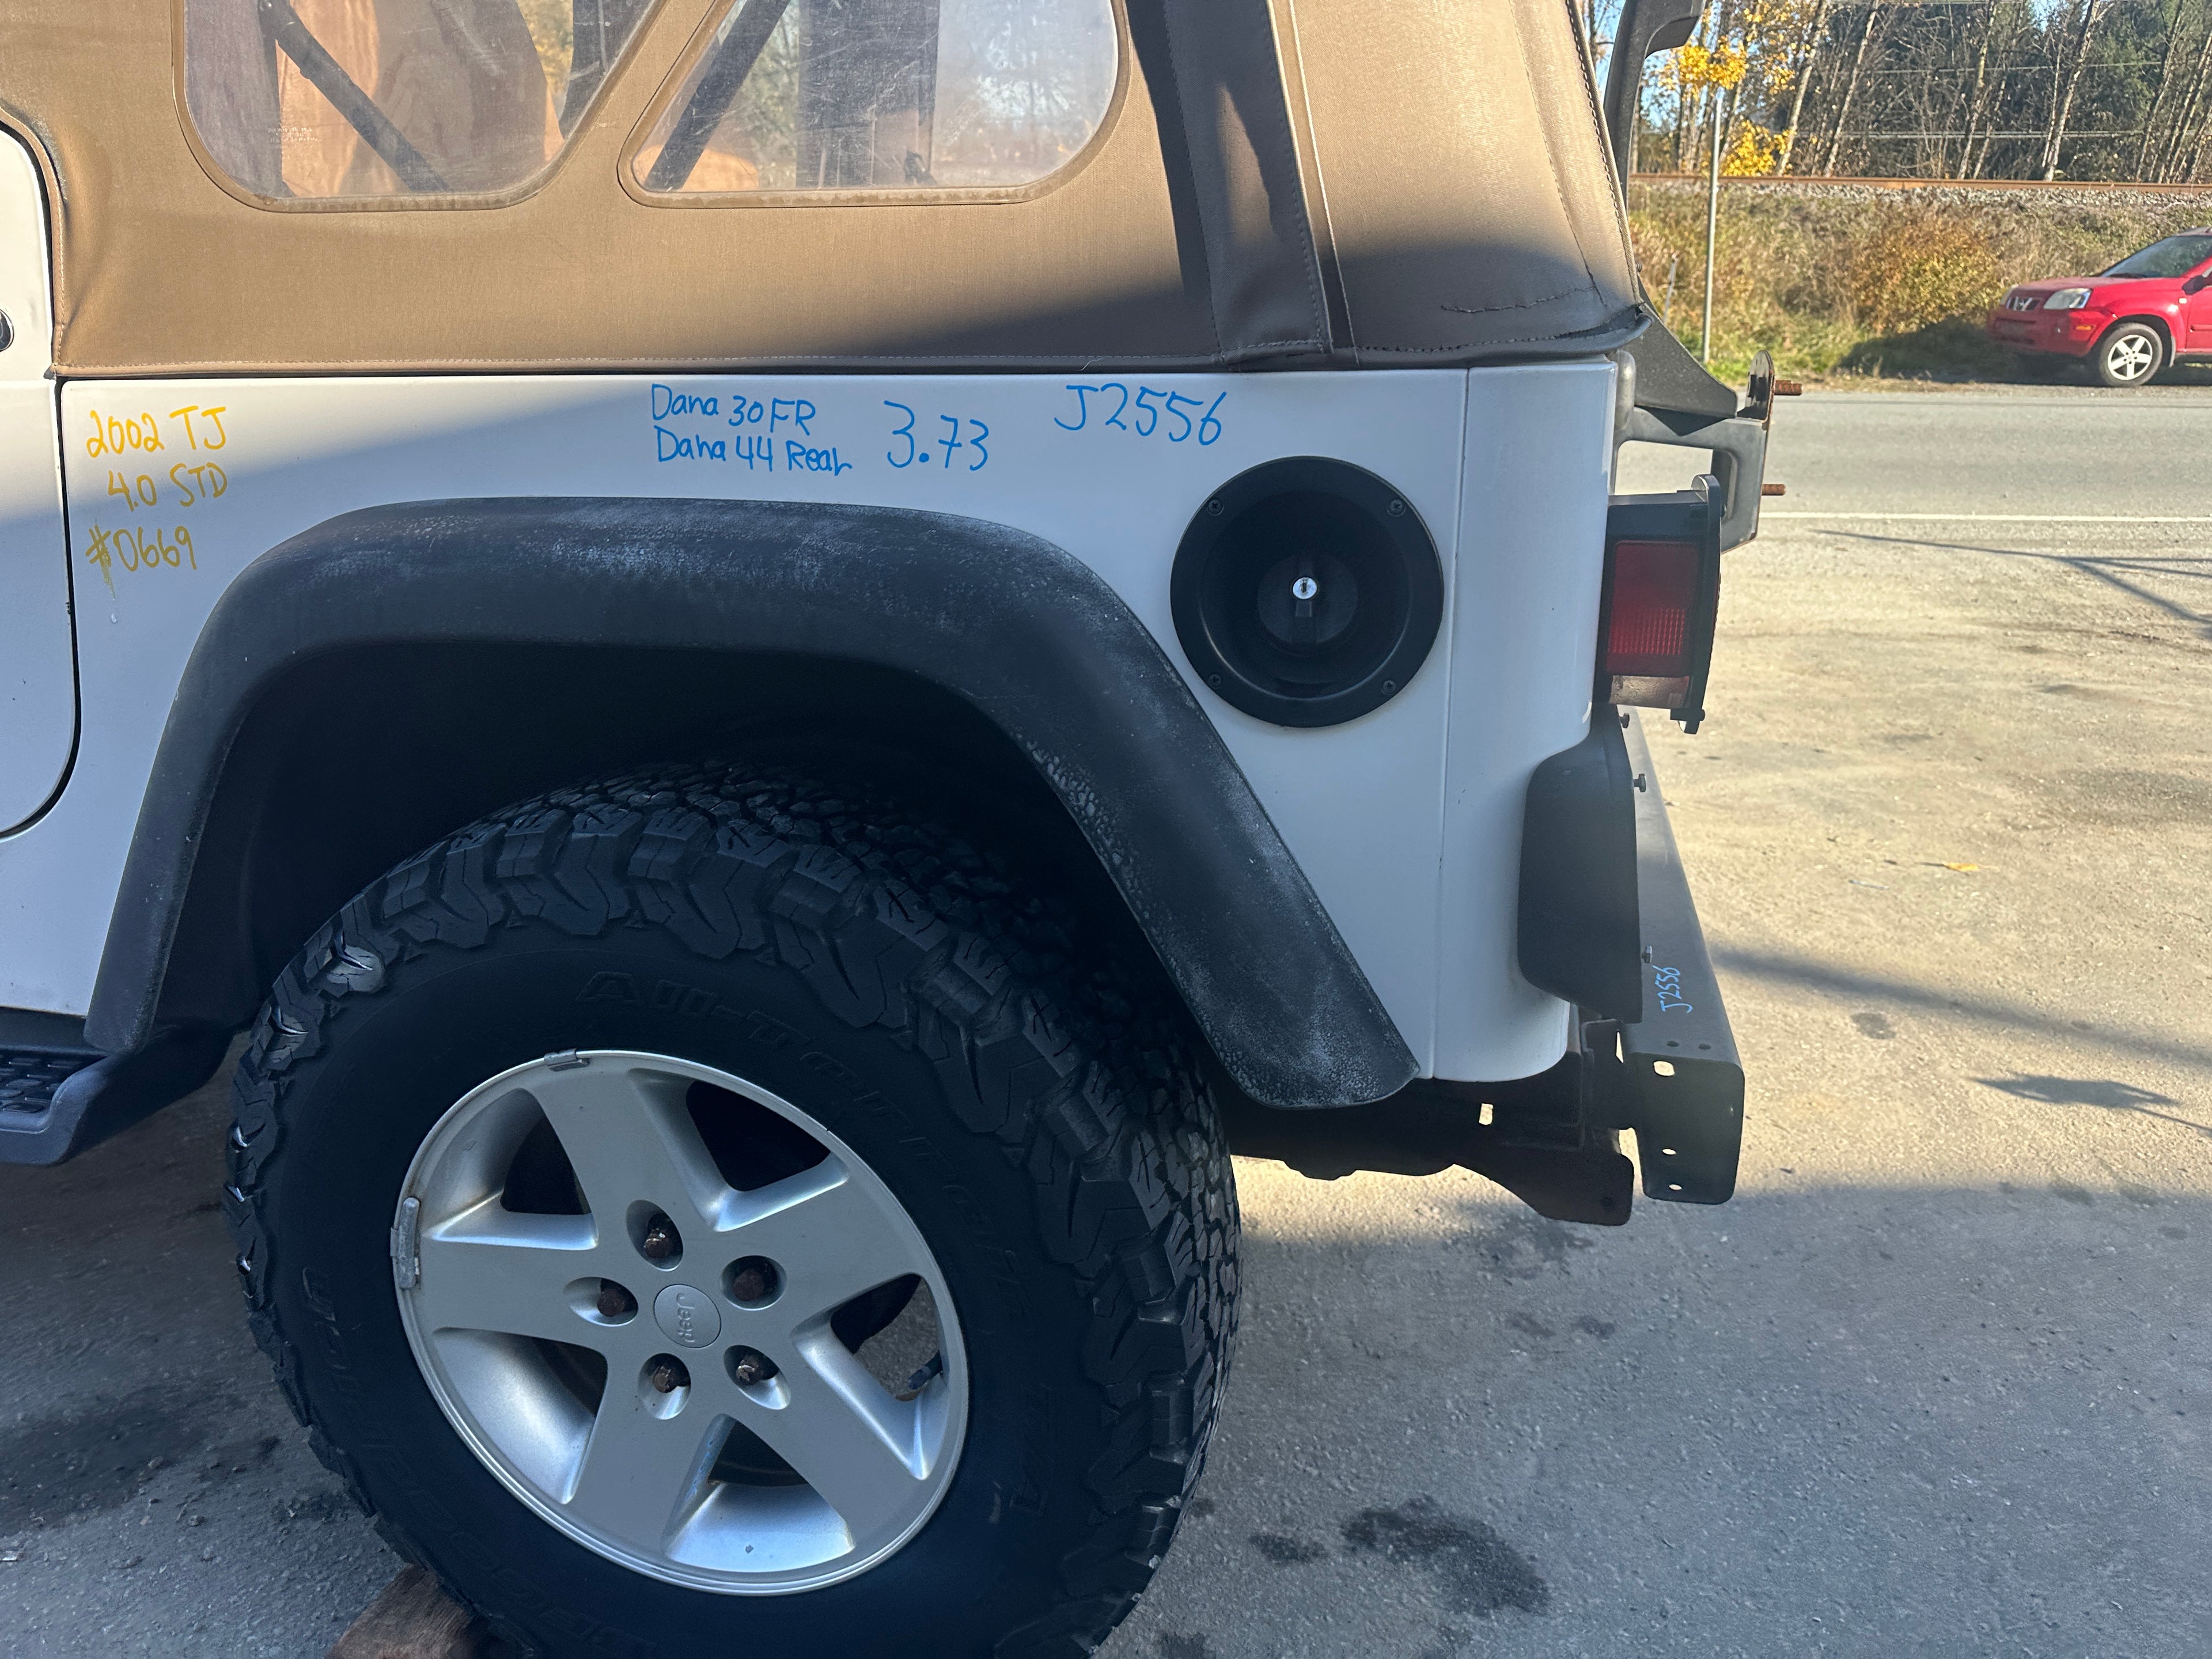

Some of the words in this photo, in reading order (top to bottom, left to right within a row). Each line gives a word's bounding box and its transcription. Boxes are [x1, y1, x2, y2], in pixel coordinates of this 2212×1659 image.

[652, 383, 719, 421] Dana
[1053, 382, 1227, 446] J2556
[86, 410, 165, 458] 2002
[169, 405, 227, 450] TJ
[654, 425, 726, 463] Dana
[736, 435, 773, 472] 44
[786, 440, 853, 476] Rear
[884, 400, 989, 471] 3.73
[107, 470, 157, 512] 4.0
[169, 462, 228, 507] STD
[85, 524, 198, 572] #0669
[1652, 964, 1693, 1014] J2556
[676, 1292, 696, 1343] Jeep
